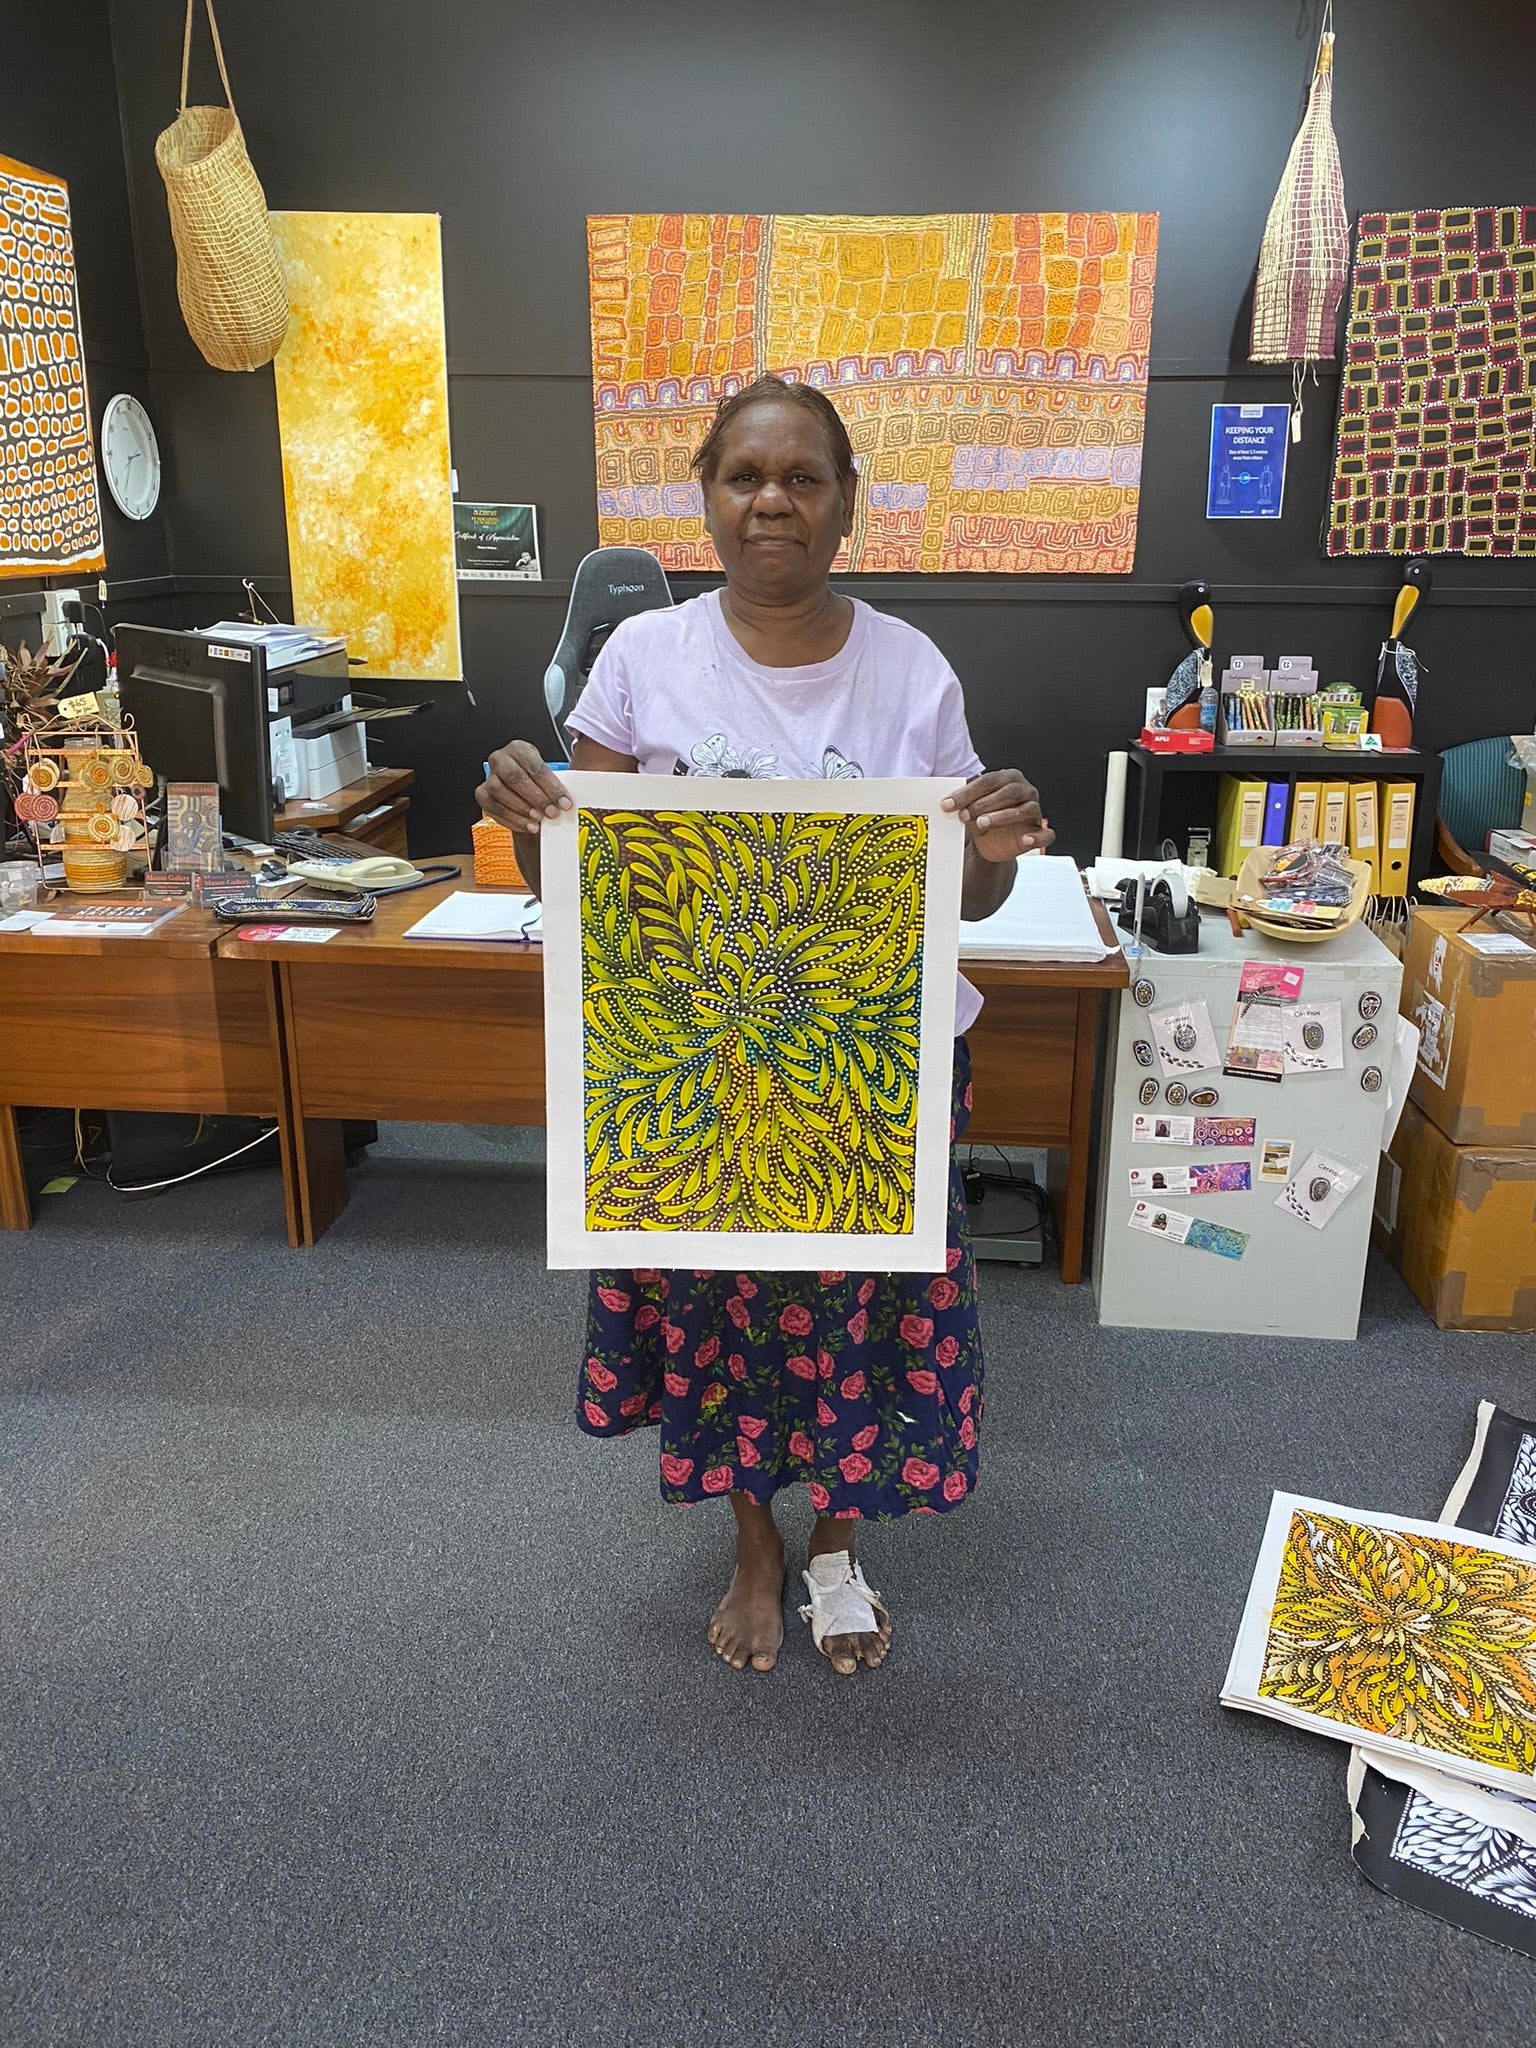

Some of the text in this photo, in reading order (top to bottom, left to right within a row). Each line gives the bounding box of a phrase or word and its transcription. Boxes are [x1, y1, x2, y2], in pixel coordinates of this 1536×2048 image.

[1225, 426, 1274, 434] KEEPING YOUR
[1233, 436, 1266, 444] DISTANCE
[607, 583, 645, 595] Typhoon
[168, 874, 190, 882] Gallery
[226, 879, 250, 887] Gallery
